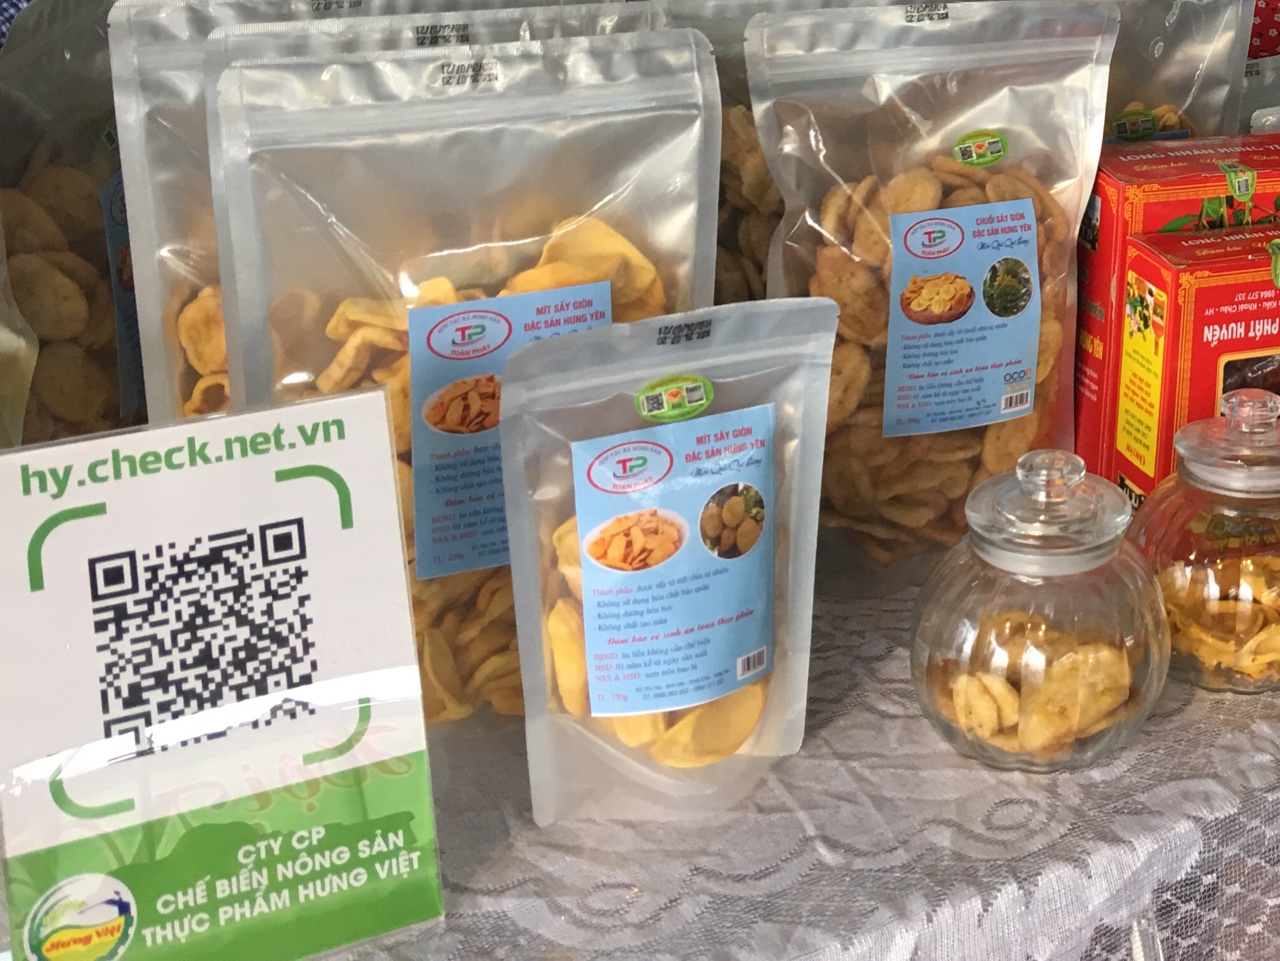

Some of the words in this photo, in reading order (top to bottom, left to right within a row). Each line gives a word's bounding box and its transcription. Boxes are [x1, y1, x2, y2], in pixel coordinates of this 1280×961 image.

[536, 304, 551, 315] MÍT
[554, 299, 571, 313] SẤY
[524, 320, 542, 332] ĐẶC
[544, 316, 561, 329] SẢN
[563, 313, 587, 326] HƯNG
[589, 310, 606, 322] YÊN
[1248, 317, 1279, 340] PHÁT
[1004, 368, 1032, 382] OCOP
[696, 431, 711, 446] MÍT
[713, 427, 730, 441] SẤY
[20, 418, 345, 500] hy.check.net.vn
[685, 452, 703, 463] ĐẶC
[705, 447, 722, 460] SẢN
[751, 438, 766, 451] YÊN
[237, 836, 283, 865] CTY
[292, 826, 326, 850] CP
[156, 875, 211, 915] CHẾ
[216, 859, 268, 899] BIẾN
[277, 845, 350, 881] NÔNG
[358, 829, 405, 858] SẢN
[141, 912, 210, 947] THỰC
[219, 885, 291, 925] PHẨM
[298, 872, 368, 903] HƯNG
[375, 851, 421, 879] VIỆT
